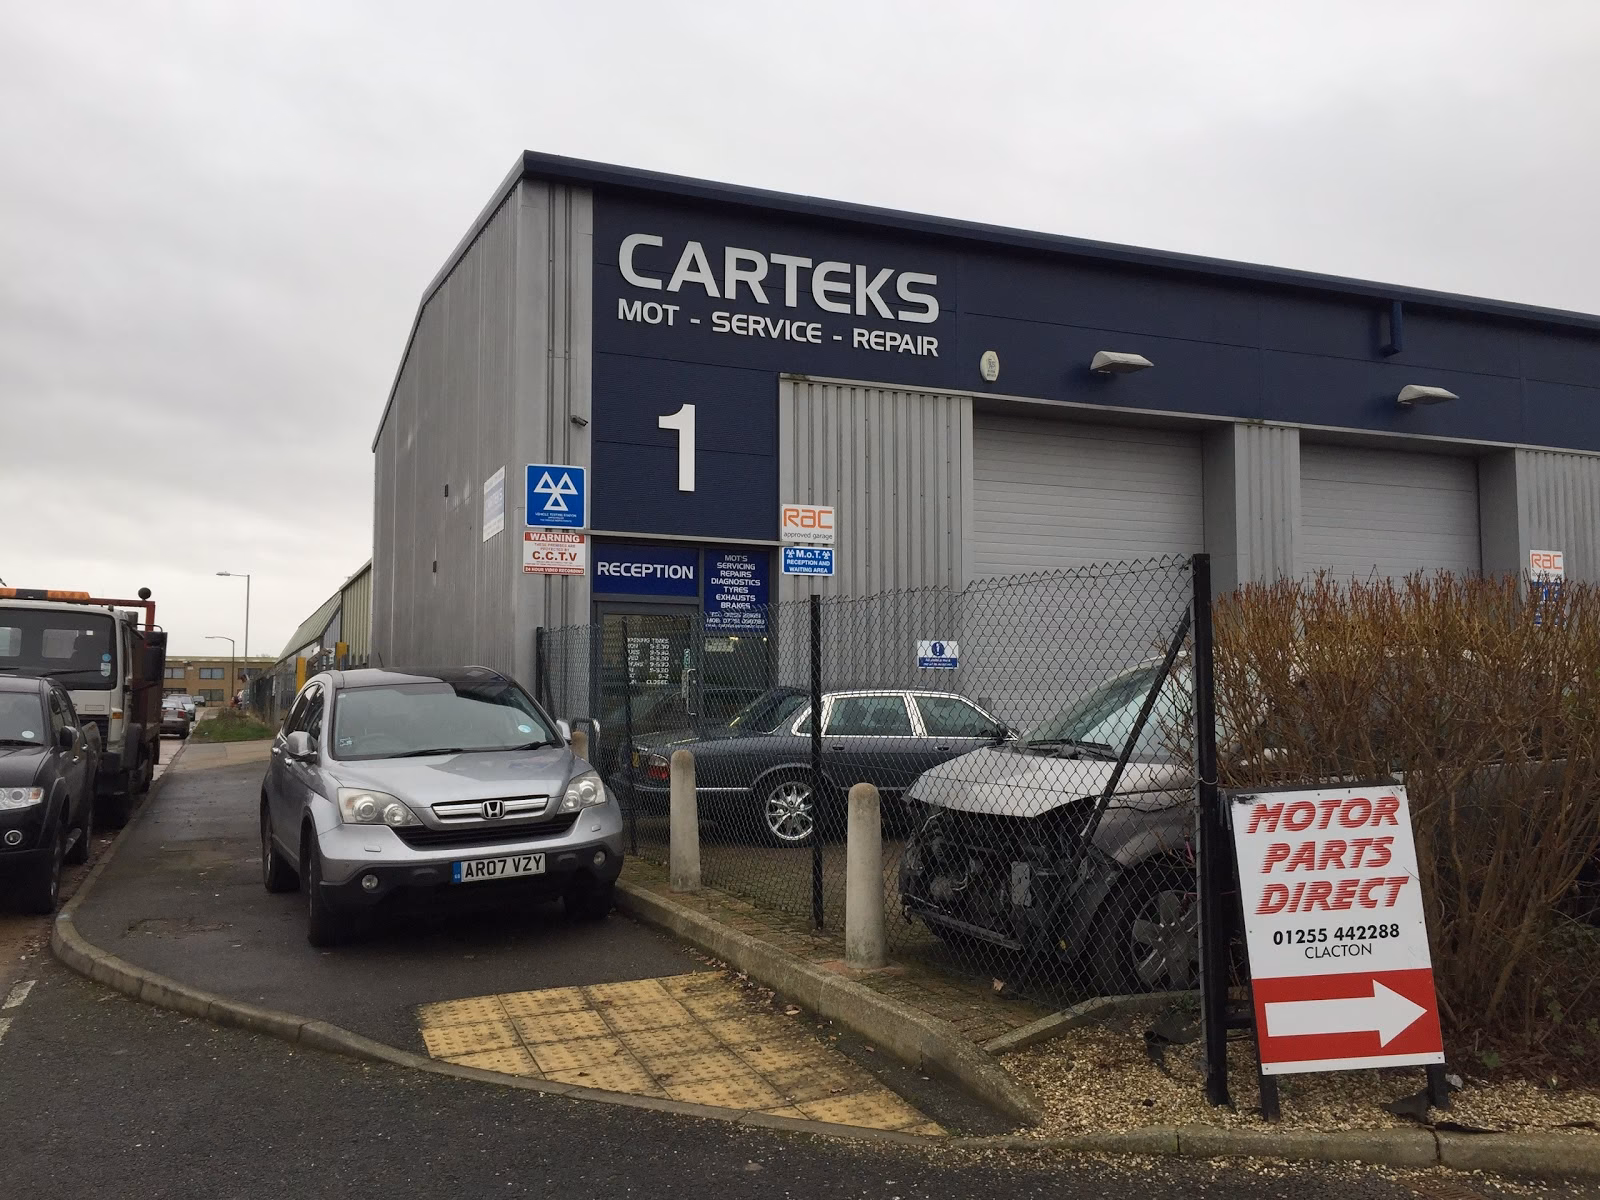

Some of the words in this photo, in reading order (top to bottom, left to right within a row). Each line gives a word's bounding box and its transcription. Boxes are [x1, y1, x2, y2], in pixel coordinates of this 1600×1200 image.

[618, 233, 940, 324] CARTEKS
[618, 298, 680, 326] MOT
[711, 311, 822, 344] SERVICE
[853, 328, 939, 357] REPAIR
[658, 403, 696, 492] 1
[530, 533, 580, 543] WARNING
[532, 550, 577, 561] C.C.T.V
[724, 554, 748, 562] MOT'S
[597, 561, 694, 580] RECEPTION
[716, 562, 756, 571] SERVICING
[720, 570, 752, 578] REPAIRS
[711, 577, 761, 587] DIAGNOSTICS
[723, 586, 749, 594] TYRES
[715, 593, 756, 602] EXHAUSTS
[720, 601, 751, 610] BRAKES
[1246, 796, 1400, 834] MOTOR
[1260, 836, 1395, 874] PARTS
[465, 859, 507, 878] AR07
[512, 855, 542, 873] VZY
[1254, 875, 1410, 915] DIRECT
[1273, 927, 1328, 946] 01255
[1333, 923, 1400, 943] 442288
[1304, 943, 1373, 960] CLACTON
